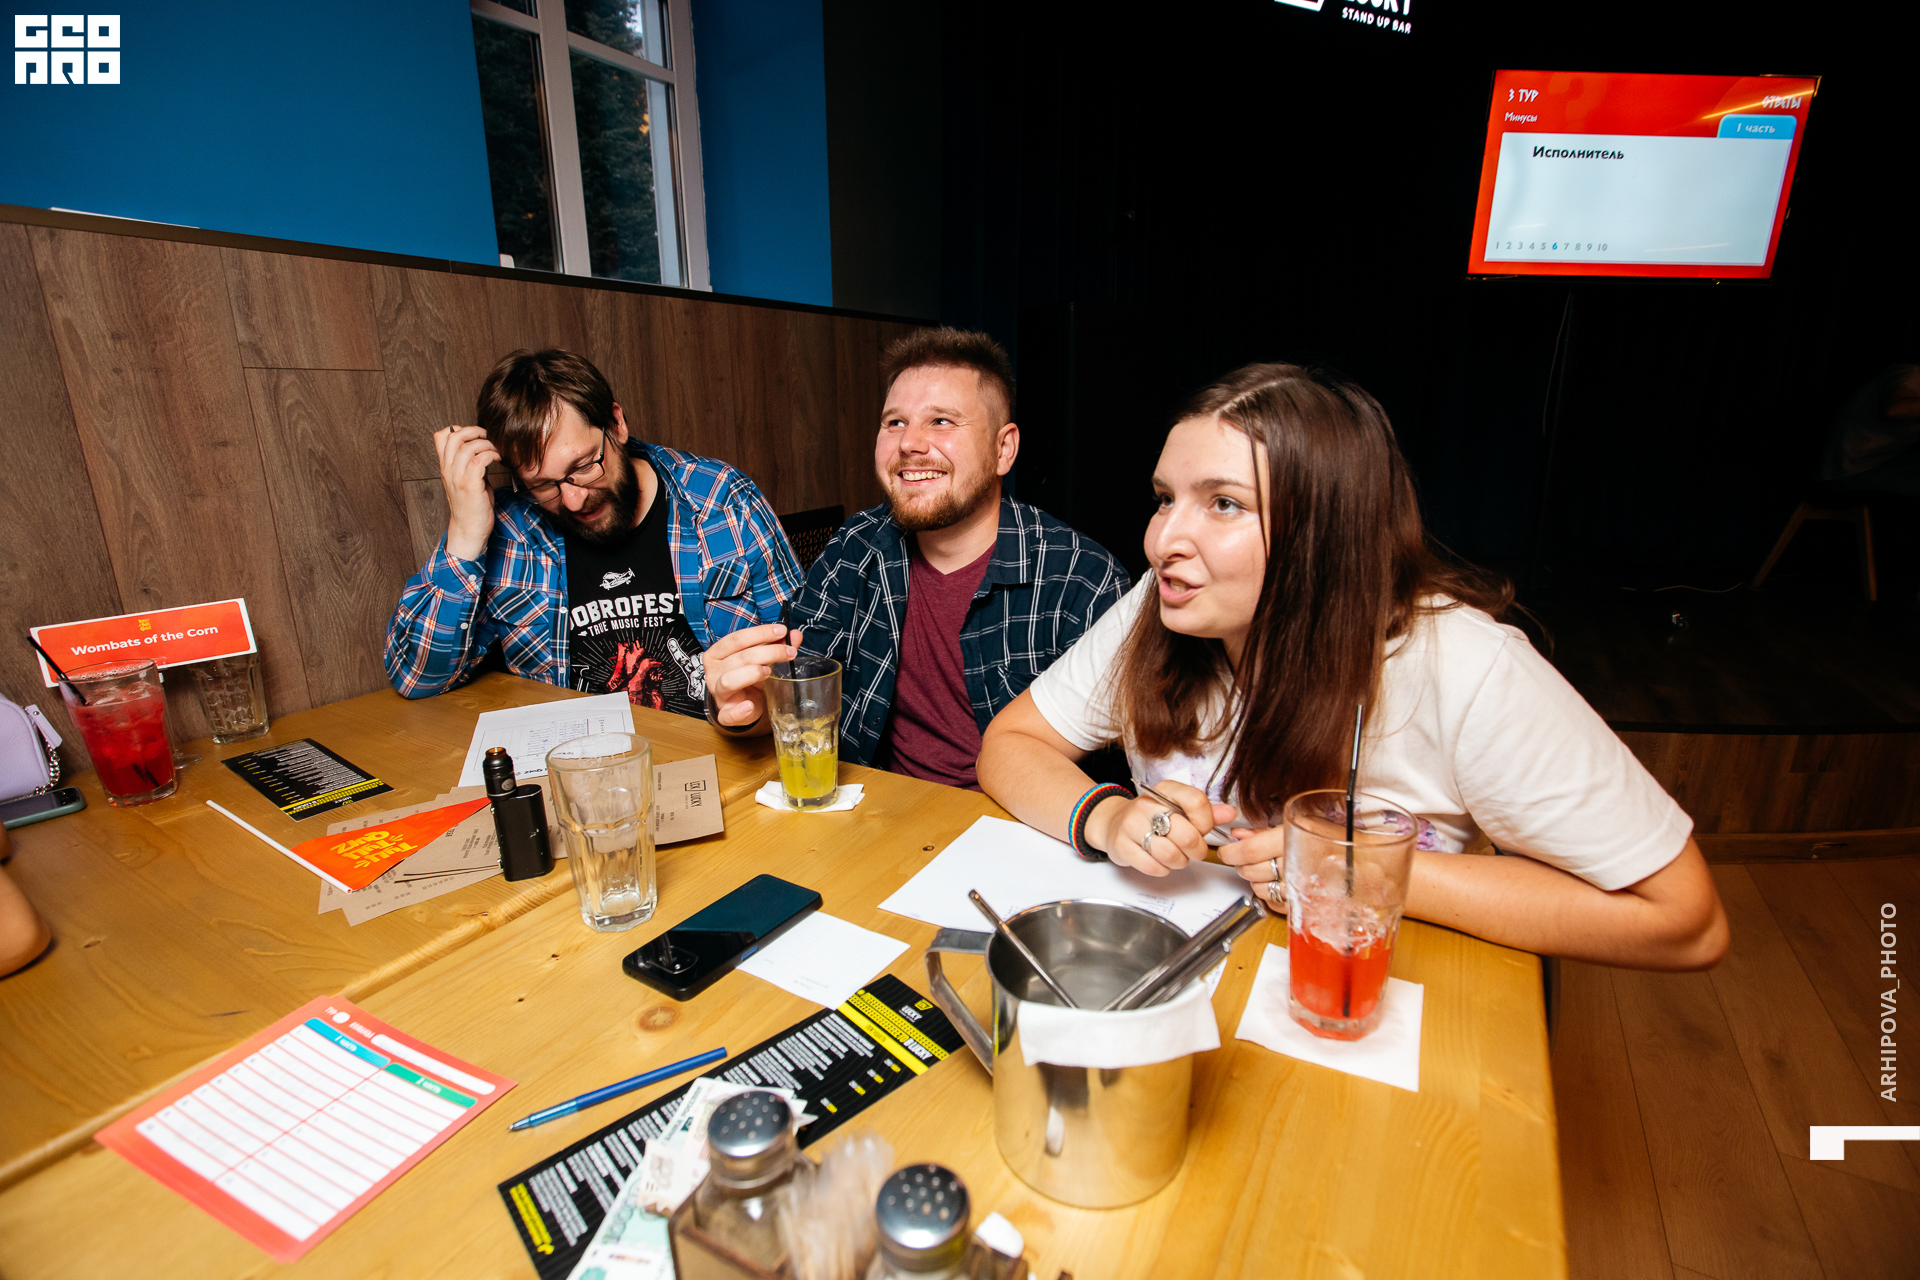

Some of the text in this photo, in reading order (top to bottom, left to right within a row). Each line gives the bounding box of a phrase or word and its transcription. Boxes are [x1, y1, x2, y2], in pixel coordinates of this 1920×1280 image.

[1341, 6, 1375, 25] STAND
[1376, 15, 1391, 28] UP
[1391, 19, 1412, 34] BAR
[1508, 88, 1539, 102] 3 ТУР
[1504, 112, 1538, 124] Минусы
[1745, 125, 1776, 134] часть
[1532, 145, 1625, 160] Исполнитель
[1495, 241, 1608, 251] 1 2 3 4 5 6 7 8 9 10
[588, 616, 664, 637] TRUE MUSIC FEST
[70, 626, 219, 656] Wombats of the Corn
